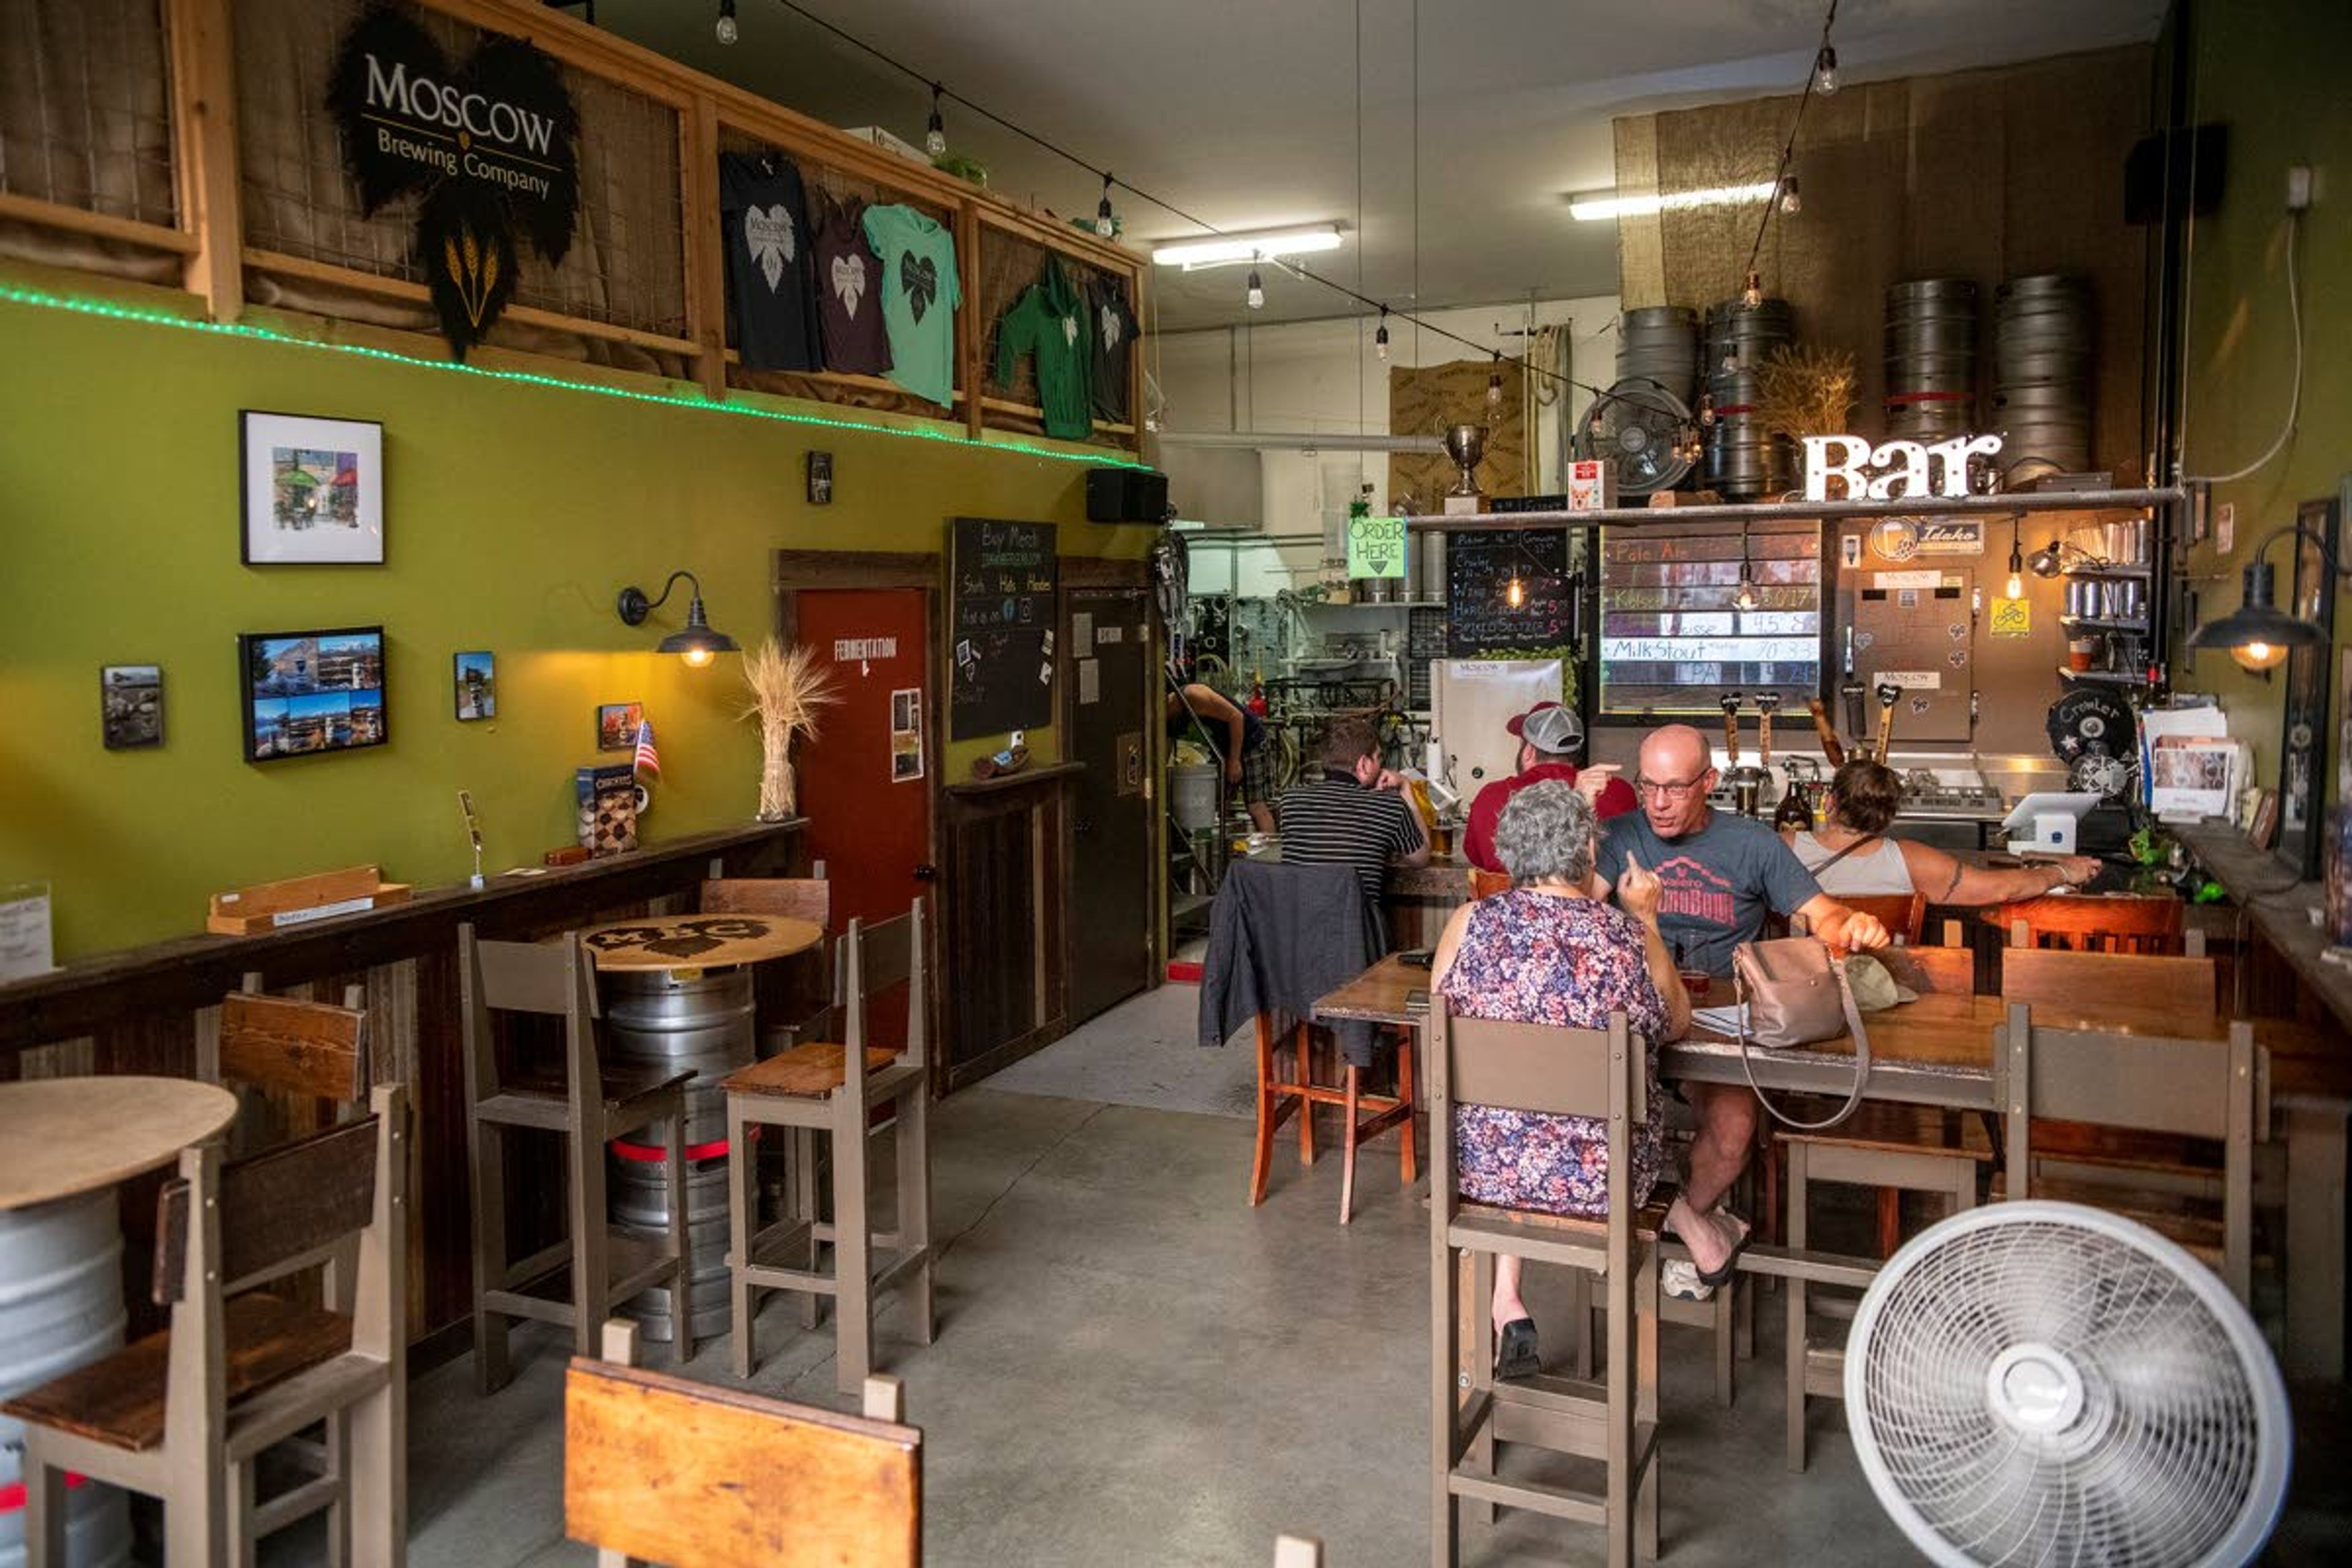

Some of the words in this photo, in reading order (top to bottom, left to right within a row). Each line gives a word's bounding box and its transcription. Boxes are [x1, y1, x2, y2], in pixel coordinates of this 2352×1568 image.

[364, 53, 554, 156] MOSCOW
[377, 129, 458, 176] Brewing
[464, 153, 551, 200] Company
[1801, 434, 2003, 502] Bar
[1350, 521, 1404, 540] ORDER
[1920, 525, 1977, 542] Idaho
[1356, 541, 1398, 559] HERE
[1616, 543, 1652, 562] Pale
[1660, 541, 1689, 559] Ale
[834, 637, 897, 662] FERMENTATION
[1612, 640, 1652, 659] Milk
[1654, 639, 1706, 661] Stout
[2059, 699, 2120, 724] Crowler
